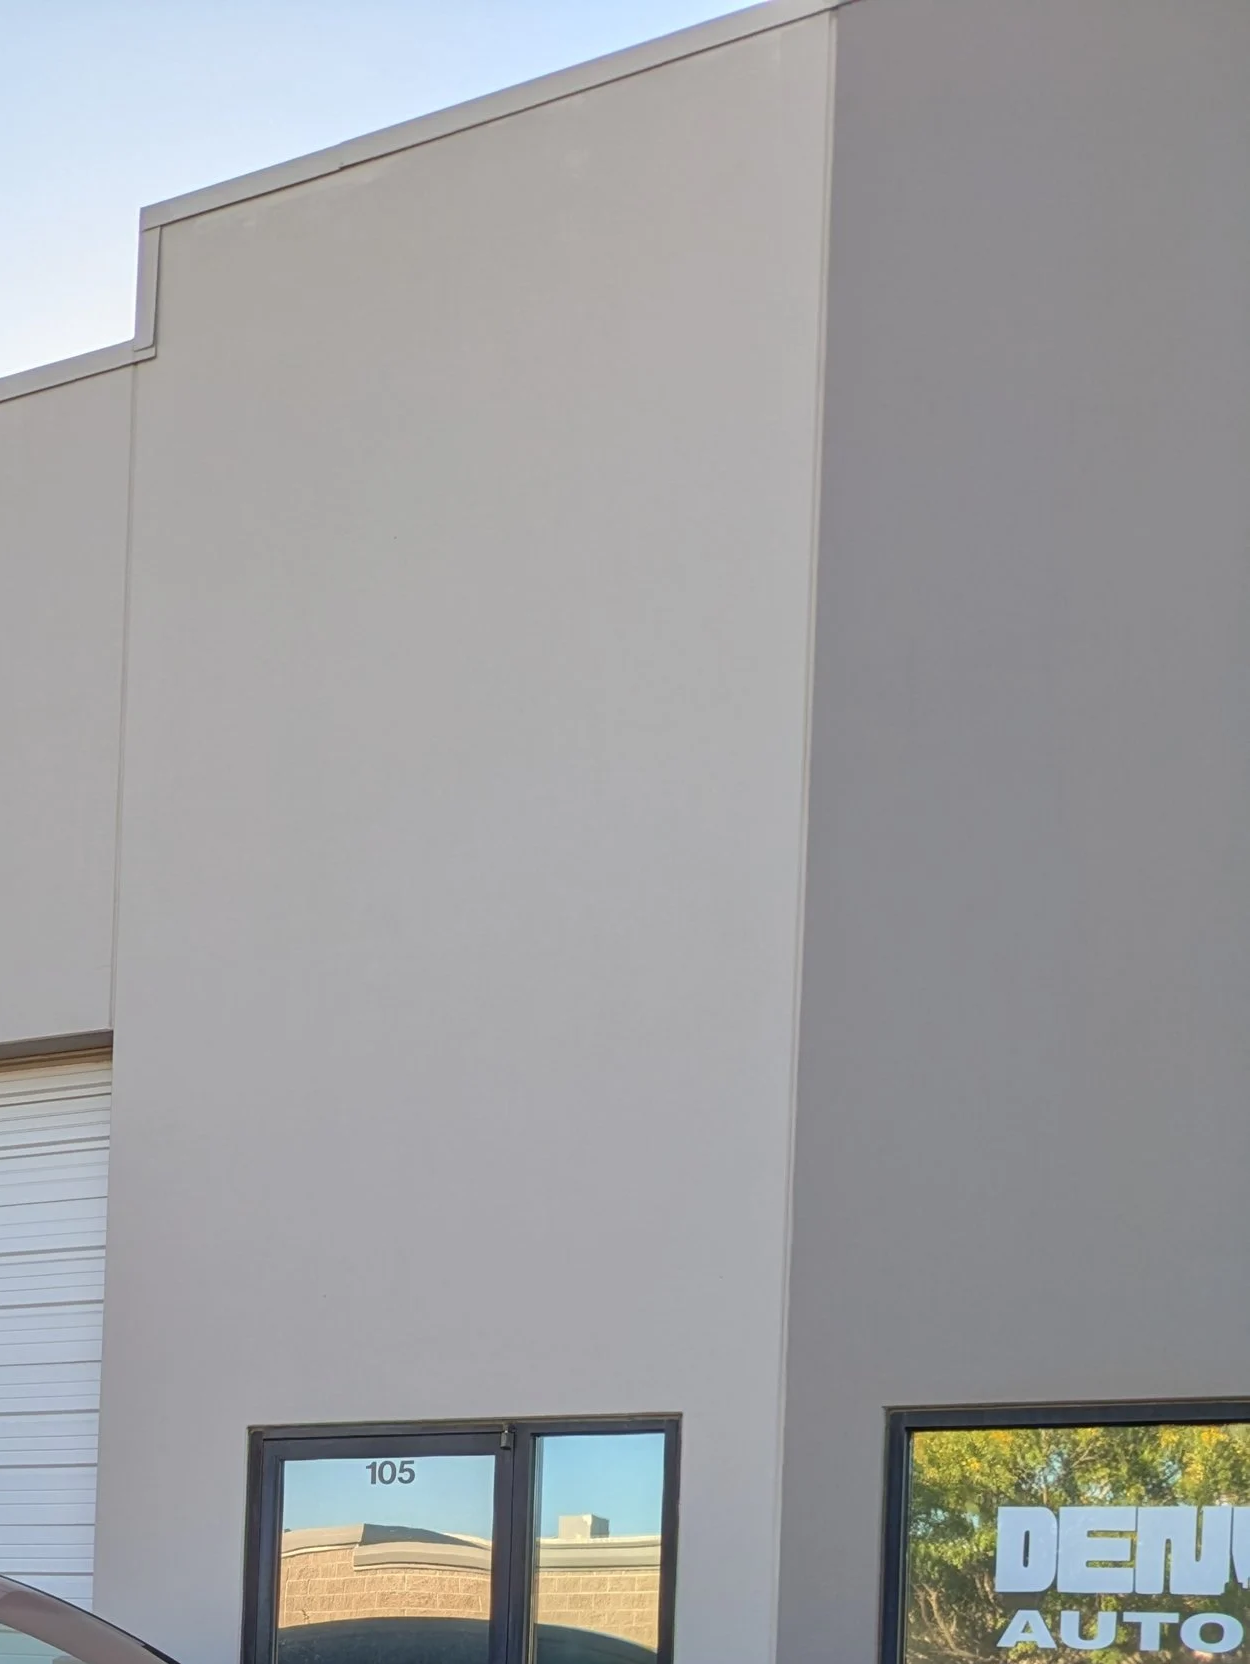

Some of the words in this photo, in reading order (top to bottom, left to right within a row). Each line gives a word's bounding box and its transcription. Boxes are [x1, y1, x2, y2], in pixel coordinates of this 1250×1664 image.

[366, 1460, 416, 1485] 105
[994, 1506, 1250, 1595] DEN
[996, 1610, 1244, 1653] AUTO
